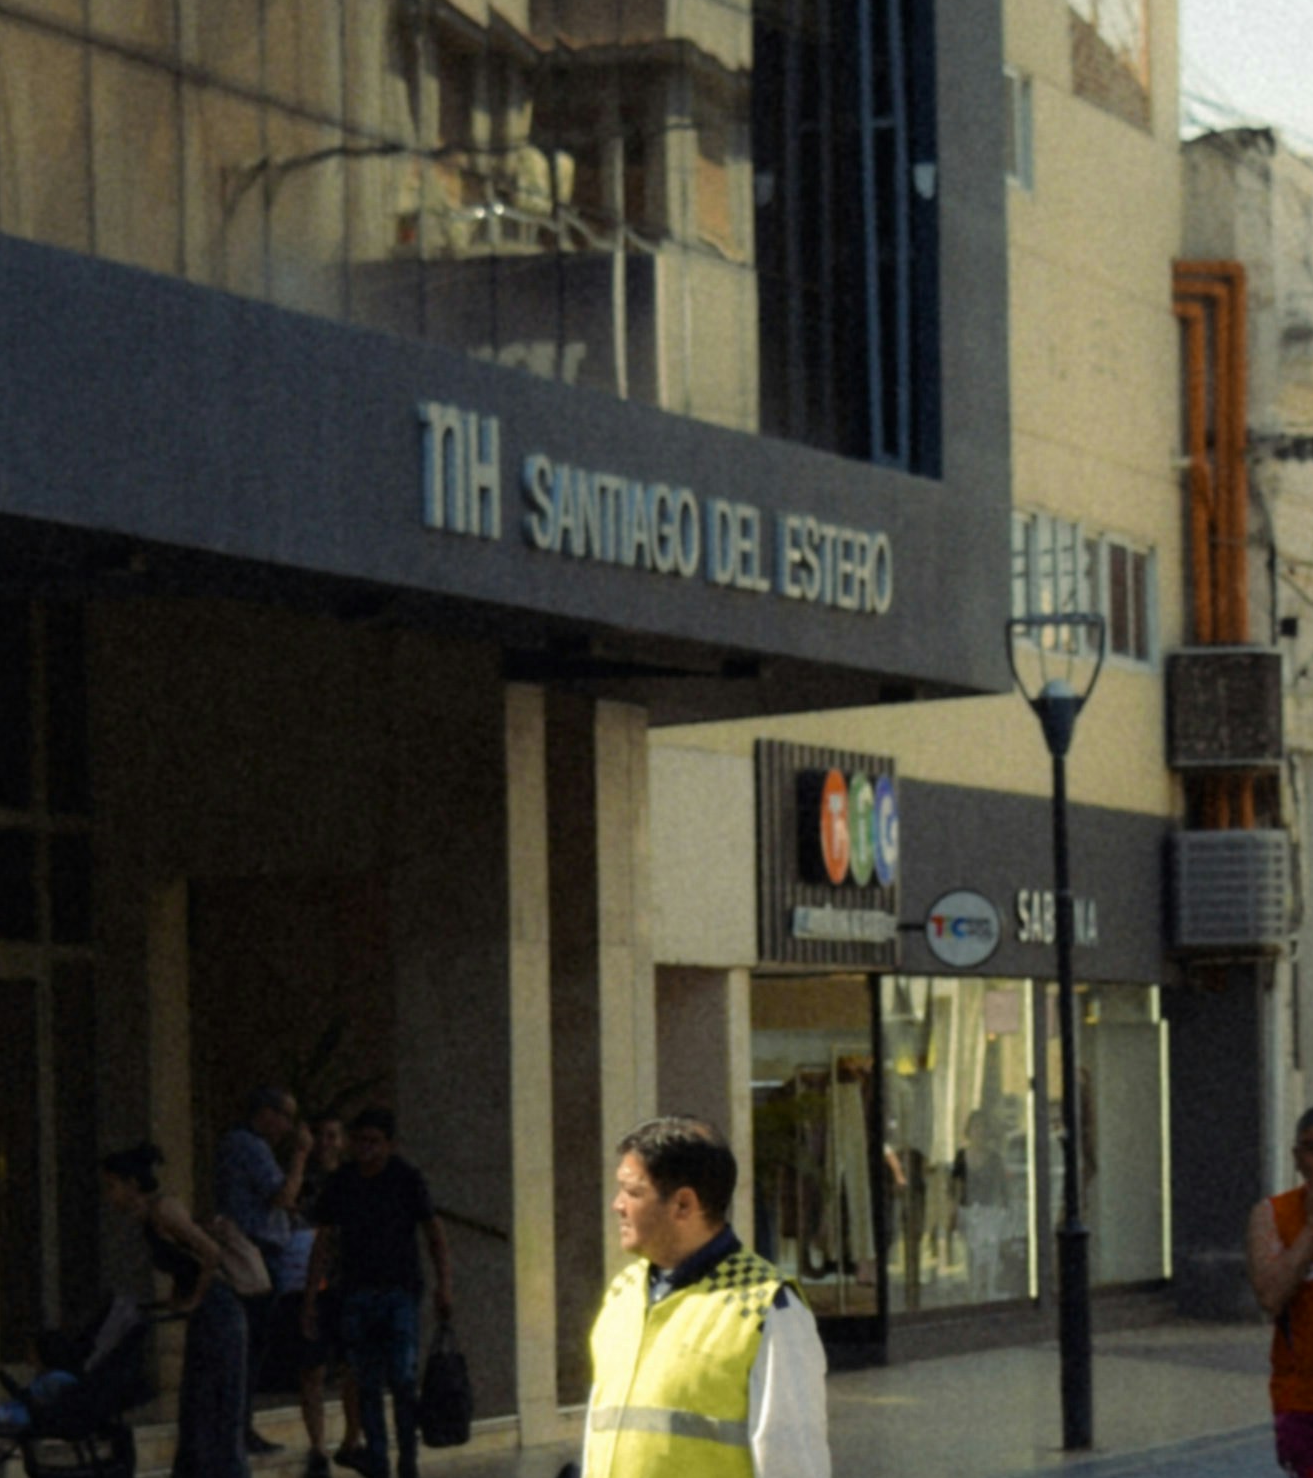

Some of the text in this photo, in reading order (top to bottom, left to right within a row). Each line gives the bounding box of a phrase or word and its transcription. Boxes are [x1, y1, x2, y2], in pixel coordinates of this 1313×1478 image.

[523, 452, 701, 579] SANTIAGO
[706, 495, 771, 593] DEL
[775, 510, 894, 616] ESTERO
[1018, 888, 1098, 947] SABNA
